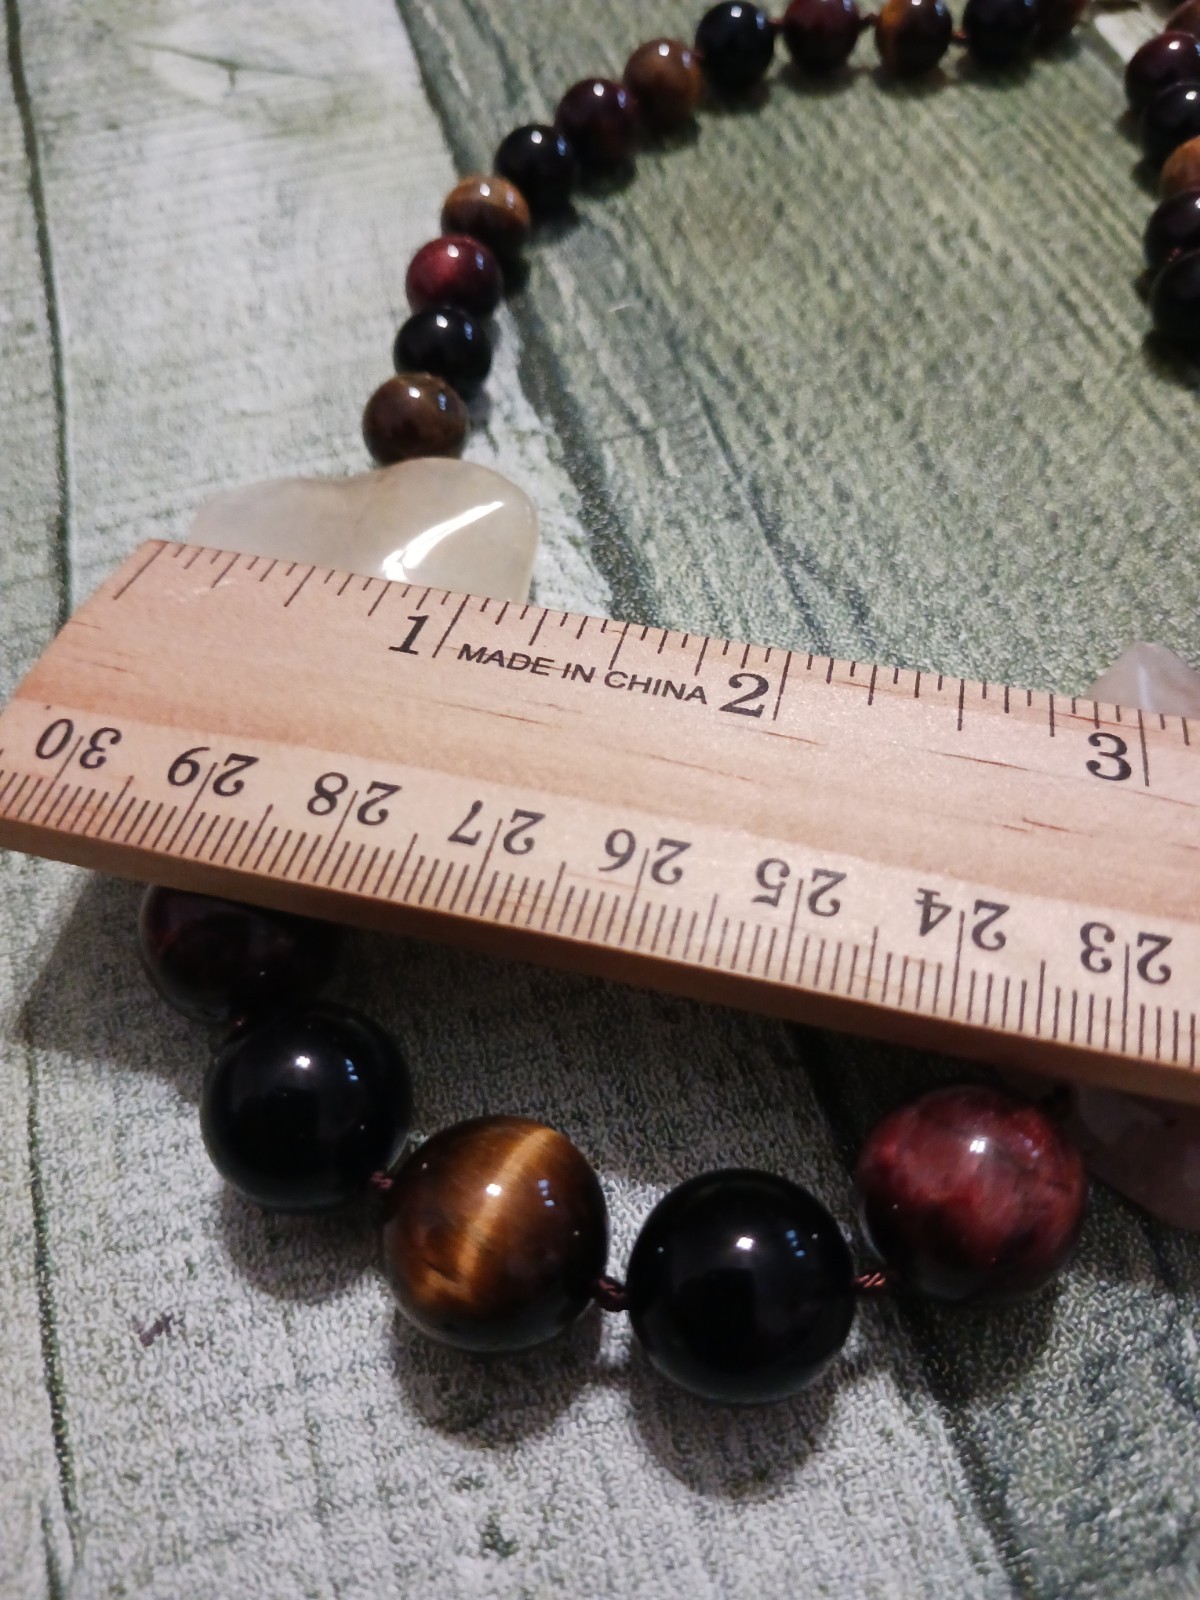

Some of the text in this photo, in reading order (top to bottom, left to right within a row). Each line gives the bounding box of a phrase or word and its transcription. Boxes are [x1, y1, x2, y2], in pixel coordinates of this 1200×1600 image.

[389, 614, 1132, 781] 1 2 3
[457, 643, 708, 705] MADE IN CHINA
[36, 718, 1172, 985] 23 24 25 26 27 28 29 30
